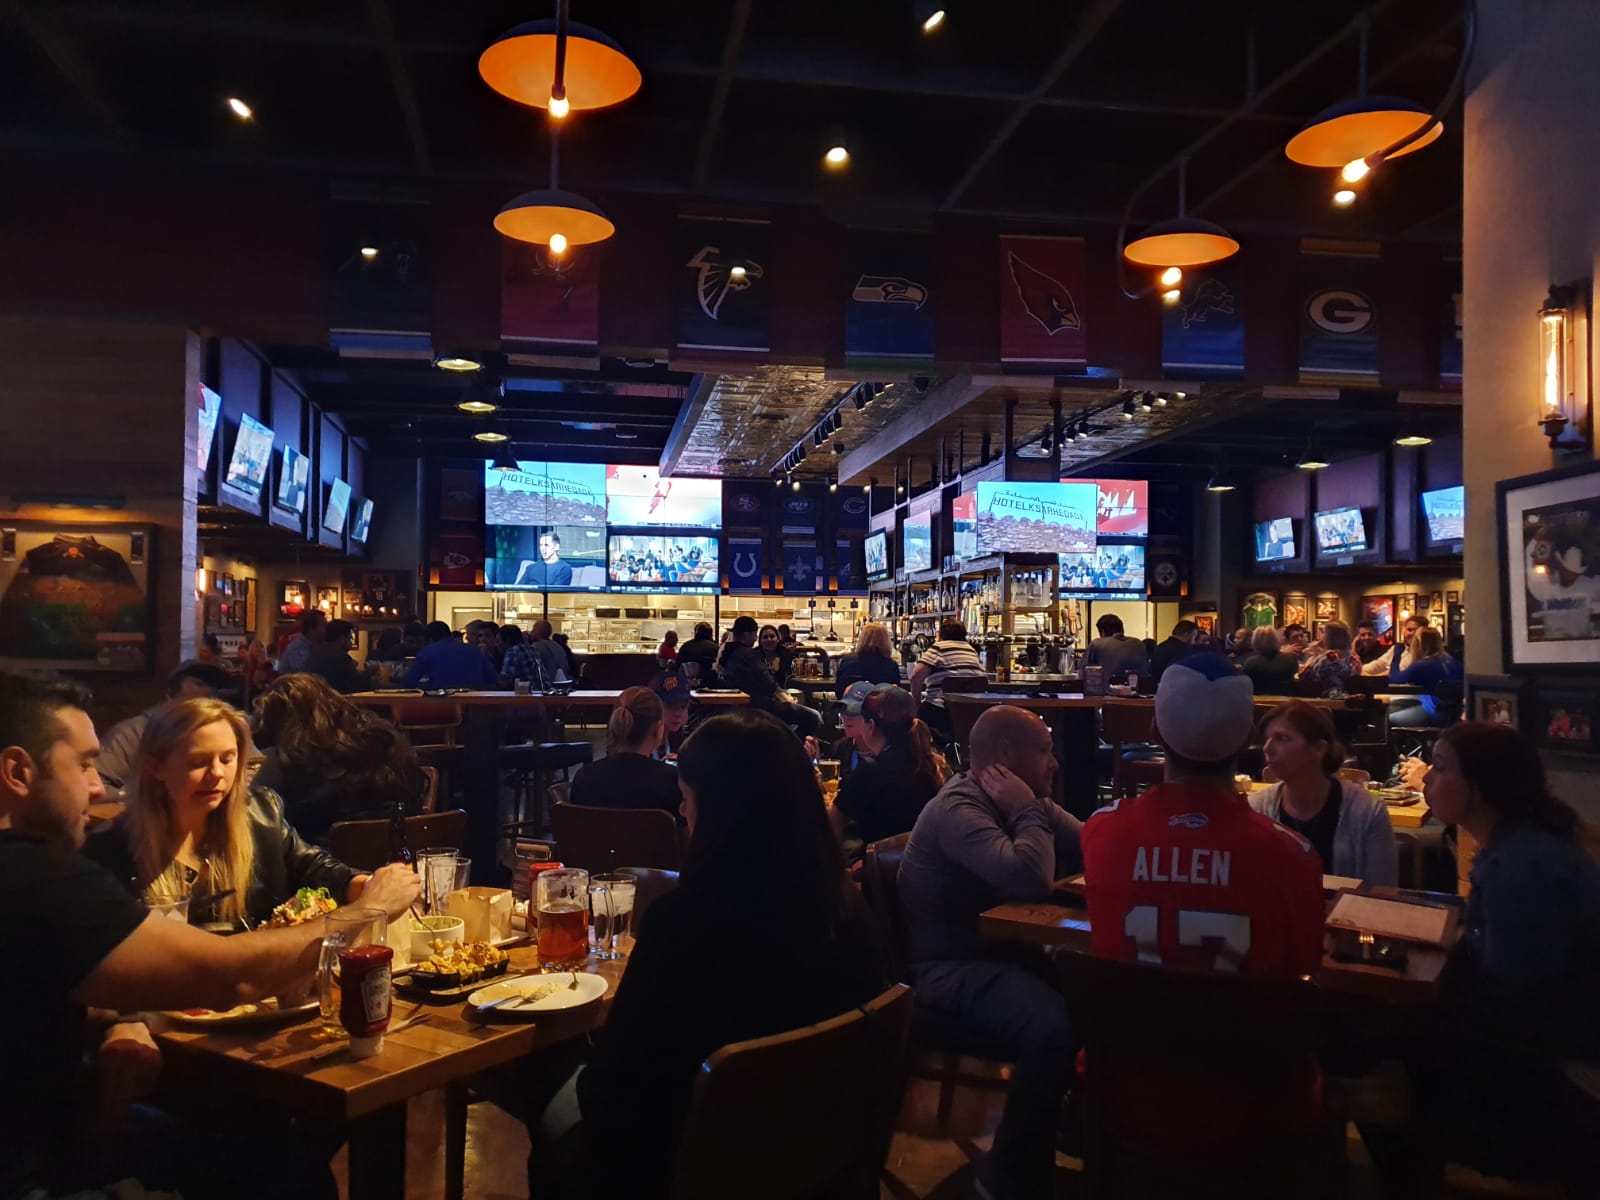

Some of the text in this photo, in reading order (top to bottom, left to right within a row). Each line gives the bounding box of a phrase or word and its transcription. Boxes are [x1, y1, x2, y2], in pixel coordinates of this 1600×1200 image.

[1308, 290, 1372, 334] G
[1132, 846, 1231, 886] ALLEN
[1124, 905, 1251, 973] 17
